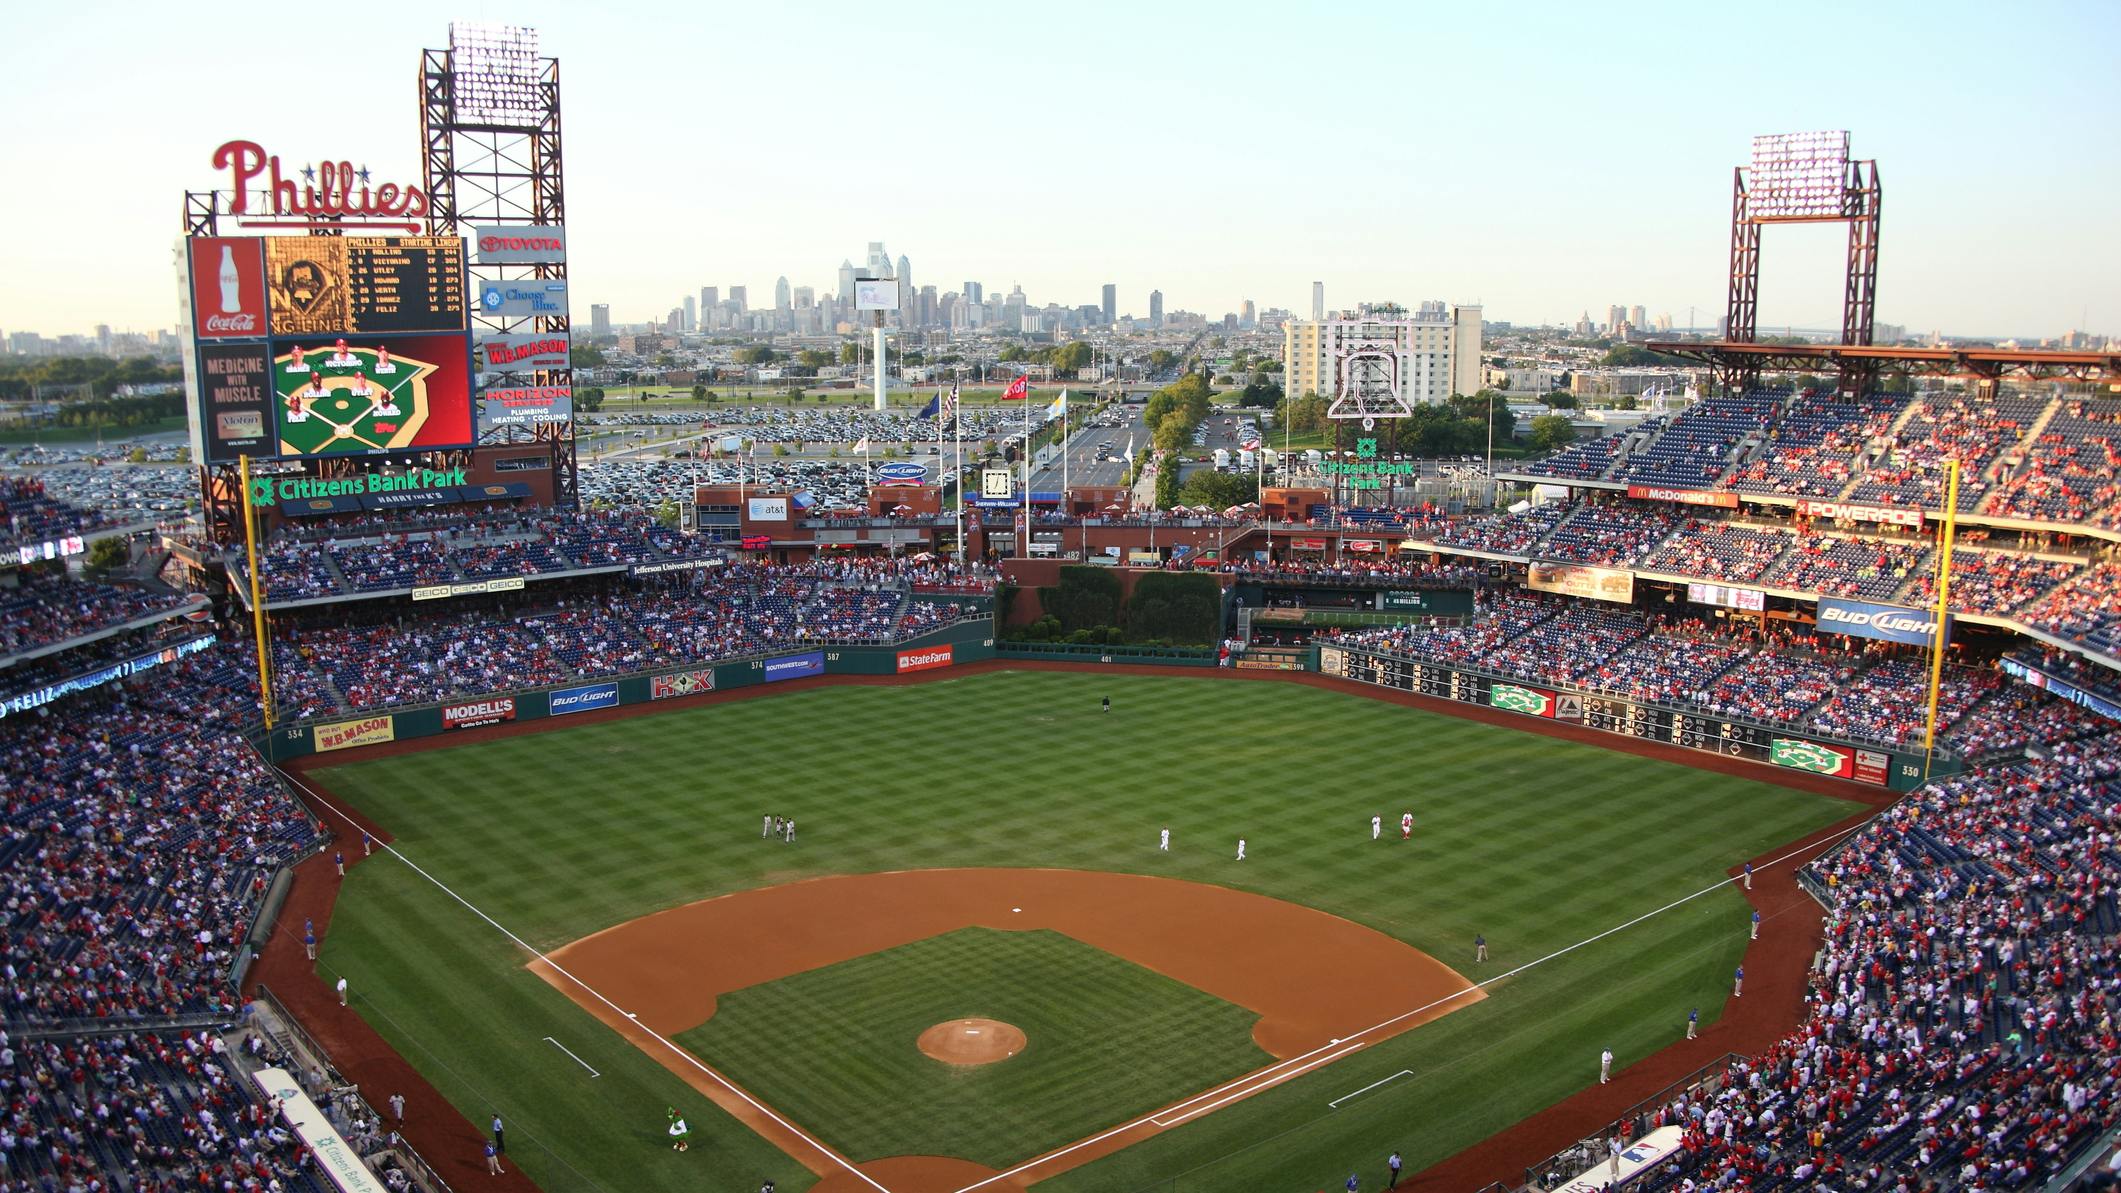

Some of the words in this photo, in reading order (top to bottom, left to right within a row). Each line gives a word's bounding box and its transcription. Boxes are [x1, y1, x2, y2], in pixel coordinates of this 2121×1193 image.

[212, 140, 429, 217] Phillies
[347, 238, 387, 247] PHILLIES
[400, 238, 432, 247] STARTING
[435, 238, 461, 247] LINEUP
[499, 237, 562, 251] TOYOTA
[505, 288, 545, 300] Choose
[532, 300, 559, 311] Blue.
[207, 358, 264, 374] MEDICINE
[227, 374, 248, 387] WITH
[214, 387, 262, 403] MUSCLE
[486, 387, 571, 401] HORIZON
[492, 416, 525, 424] HEATING
[532, 414, 568, 422] COOLING
[511, 408, 549, 416] PLUMBING
[1318, 461, 1375, 474] Citizens
[1377, 461, 1414, 474] Bank
[279, 476, 364, 500] Citizens
[368, 472, 420, 493] Bank
[422, 467, 468, 488] Park
[1349, 476, 1381, 489] Park
[378, 495, 412, 503] HARRY
[1648, 489, 1715, 504] McDonald's
[765, 504, 785, 514] at&t
[1808, 501, 1922, 525] POWERADE
[634, 565, 662, 576] Jefferson
[662, 561, 694, 572] University
[695, 557, 724, 568] Hospitals
[414, 587, 449, 599] GEICO
[453, 584, 486, 594] GEICO
[490, 578, 523, 590] GEICO
[1821, 607, 1870, 625] BUD
[1878, 615, 1940, 635] LIGHT
[14, 687, 55, 712] FELIZ
[552, 696, 578, 706] BUD
[582, 690, 616, 701] LIGHT
[445, 700, 513, 720] MODELL'S
[1902, 766, 1919, 777] 330
[326, 1147, 350, 1171] Citizens
[345, 1170, 366, 1188] Bank
